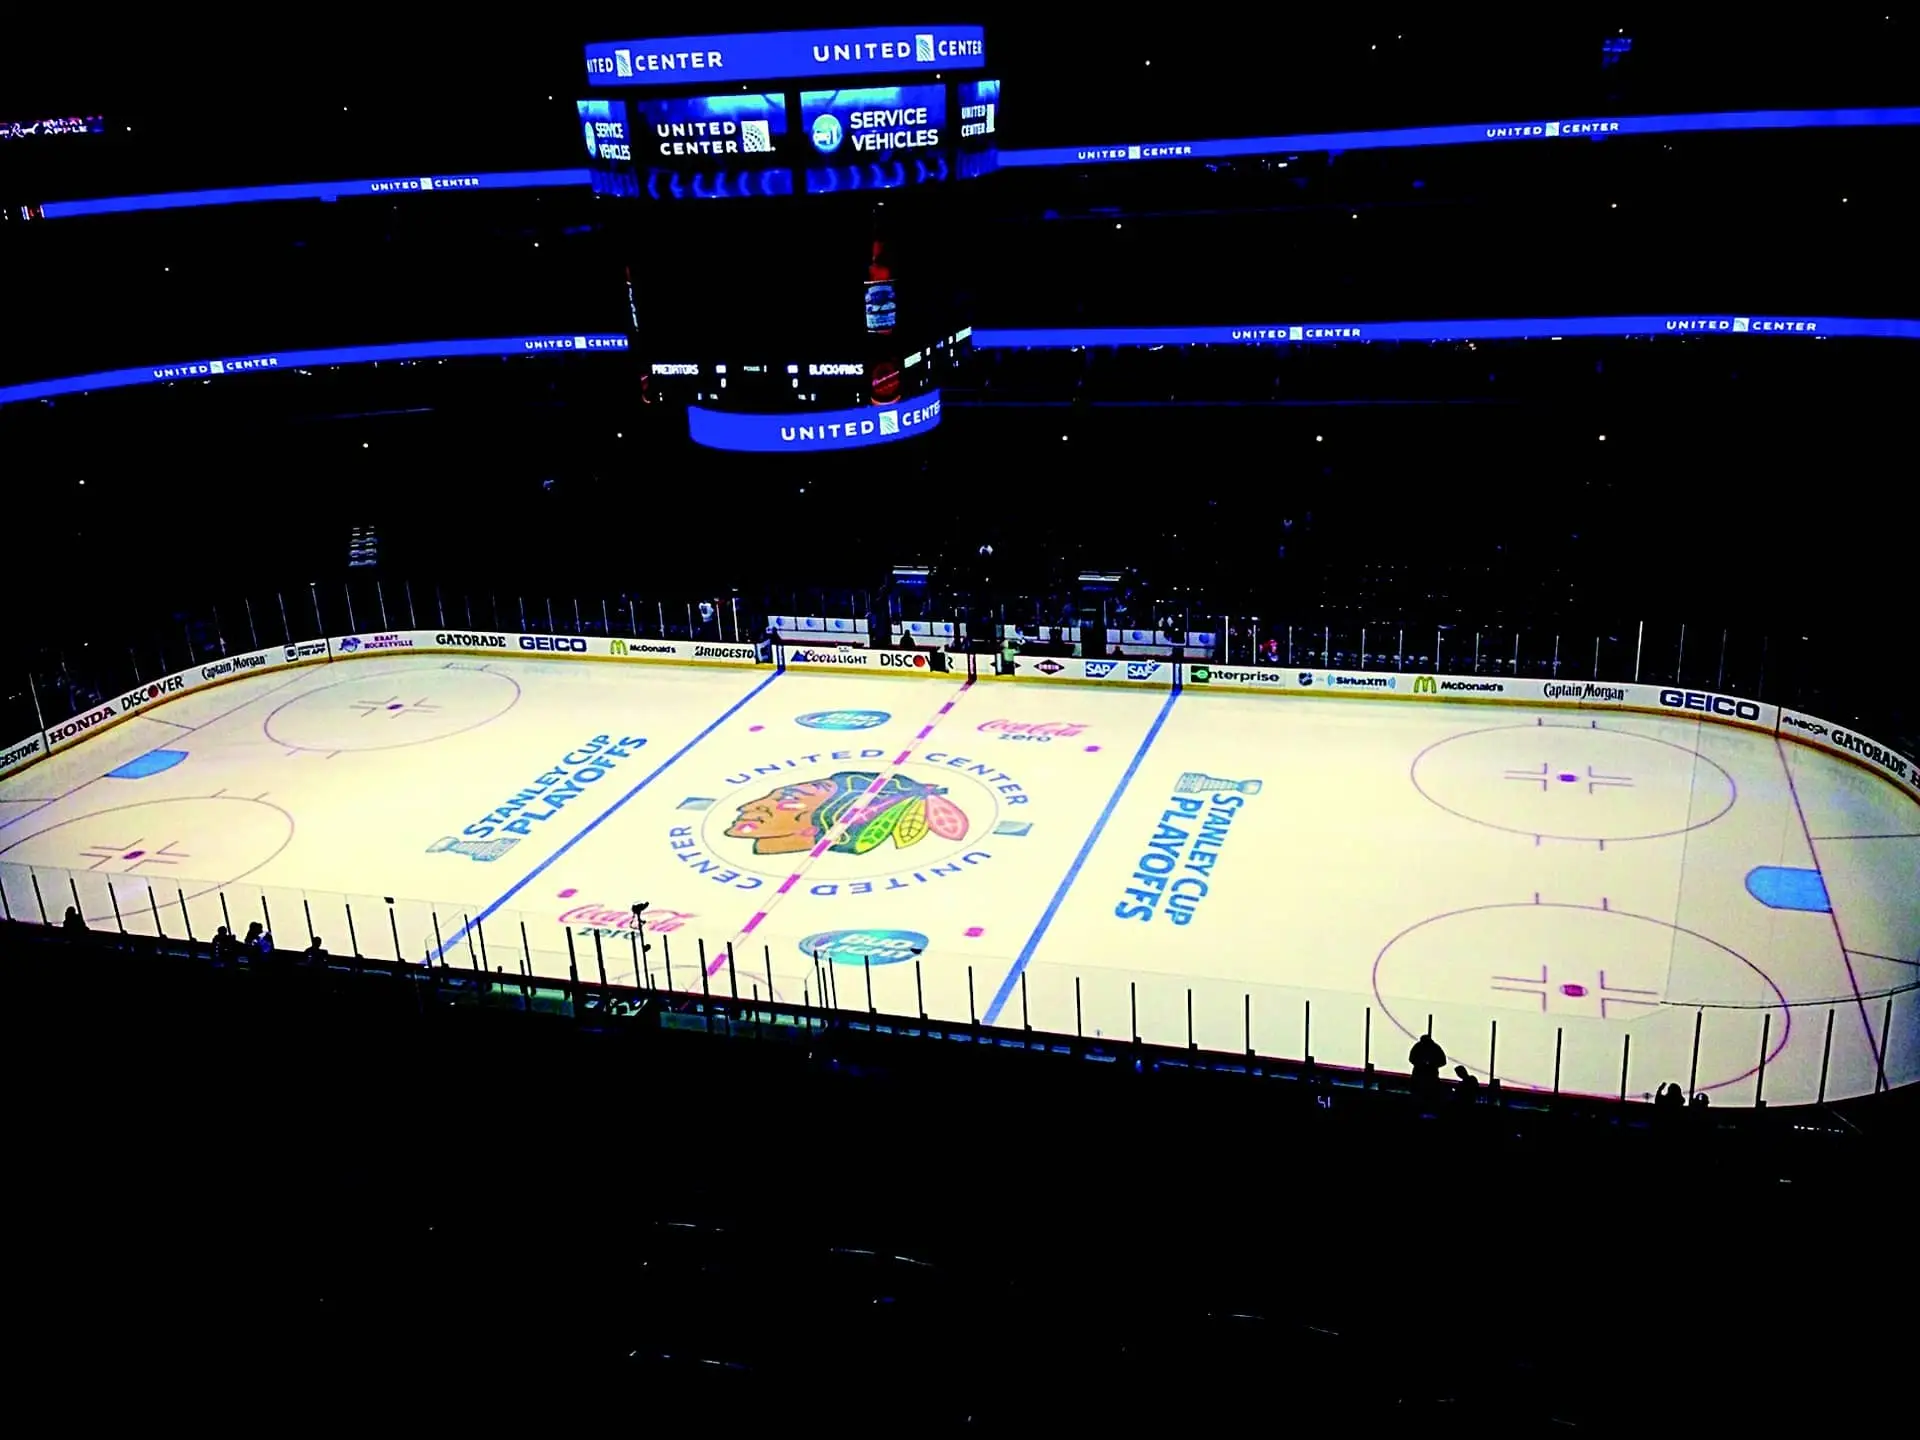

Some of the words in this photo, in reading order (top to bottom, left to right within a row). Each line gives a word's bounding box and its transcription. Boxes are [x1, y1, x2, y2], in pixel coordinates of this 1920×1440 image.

[813, 42, 910, 62] UNITED
[635, 51, 723, 71] CENTER
[850, 107, 927, 129] SERVICE
[961, 105, 985, 119] UNITED
[595, 122, 624, 139] SERVICE
[657, 121, 736, 137] UNITED
[961, 122, 985, 137] CENTER
[1486, 126, 1542, 137] UNITED
[1562, 122, 1619, 133] CENTER
[660, 140, 738, 155] CENTER
[852, 129, 939, 151] VEHICLES
[599, 144, 631, 160] VEHICLES
[1078, 149, 1126, 160] UNITED
[1143, 146, 1192, 157] CENTER
[371, 181, 418, 191] UNITED
[434, 177, 480, 188] CENTER
[1232, 329, 1287, 340] UNITED
[1306, 328, 1361, 338] CENTER
[1666, 320, 1729, 331] UNITED
[1752, 321, 1816, 331] CENTER
[525, 340, 572, 349] UNITED
[154, 363, 208, 378] UNITED
[226, 357, 278, 371] CENTER
[781, 421, 874, 441] UNITED
[436, 634, 506, 647] GATORADE
[519, 636, 587, 652] GEICO
[629, 644, 676, 653] McDonald's
[803, 650, 837, 665] Coors
[838, 655, 867, 665] LIGHT
[880, 653, 954, 670] DISCOR
[201, 658, 232, 681] Captain
[231, 654, 265, 673] Morgan
[1086, 661, 1111, 676] SAP
[121, 675, 185, 711] DISCOVER
[1441, 682, 1504, 692] McDonald's
[1544, 682, 1581, 699] Captain
[1582, 683, 1624, 700] Morgan
[1660, 690, 1760, 720] GEICO
[48, 706, 117, 745] HONDA
[998, 733, 1051, 742] zero
[1832, 729, 1908, 778] GATORADE
[463, 765, 569, 838] STANLEY
[562, 734, 610, 765] CUP
[501, 736, 648, 835] PLAYOFFS
[725, 748, 885, 786] UNITED
[925, 751, 1029, 807] CENTER
[1184, 793, 1244, 877] STANLEY
[669, 825, 763, 891] CENTER
[1114, 796, 1204, 922] PLAYOFFS
[810, 850, 993, 896] UNITED
[1164, 877, 1209, 926] CUP
